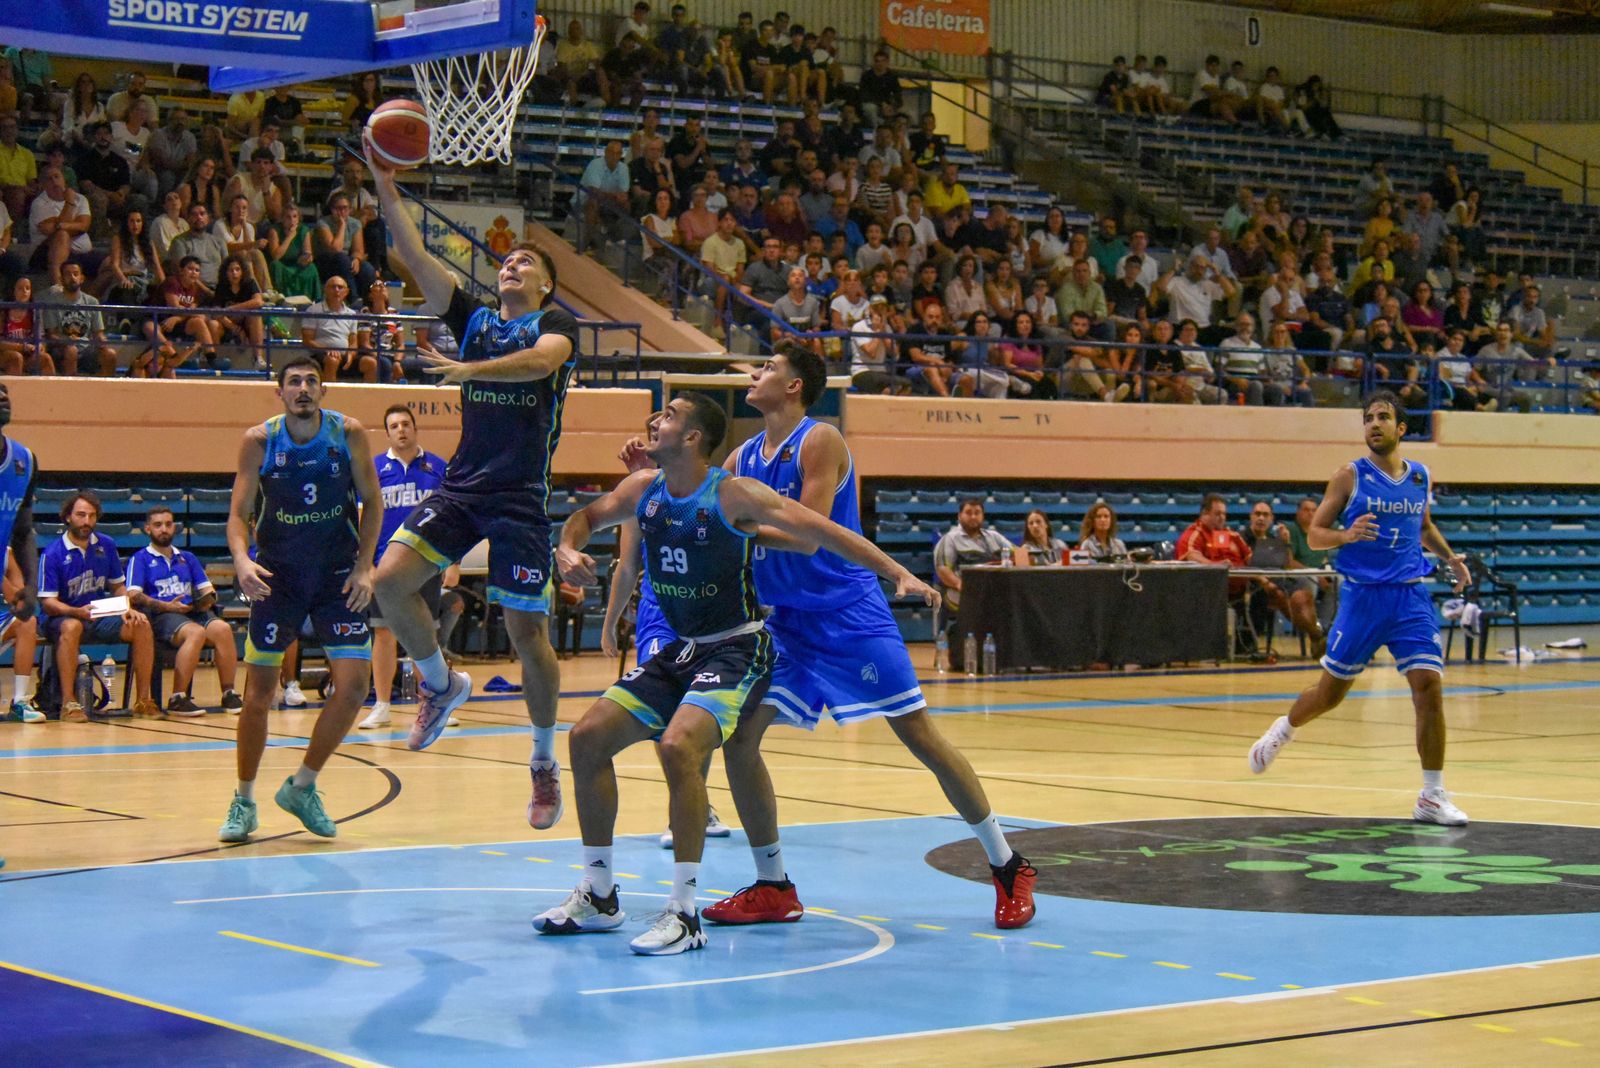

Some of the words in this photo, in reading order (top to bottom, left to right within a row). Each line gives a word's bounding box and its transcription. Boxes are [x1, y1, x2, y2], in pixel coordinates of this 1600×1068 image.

[109, 0, 199, 25] SPORT
[201, 4, 309, 35] SYSTEM
[1248, 17, 1260, 46] D
[407, 401, 462, 416] PRENS
[926, 410, 983, 424] PRENSA
[1034, 412, 1052, 425] TV
[303, 482, 318, 505] 3
[382, 488, 433, 509] HUELV
[276, 504, 343, 525] damex.io
[416, 507, 438, 528] 7
[1389, 527, 1400, 549] 7
[659, 545, 689, 574] 29
[264, 622, 279, 645] 3
[1331, 629, 1344, 652] 7
